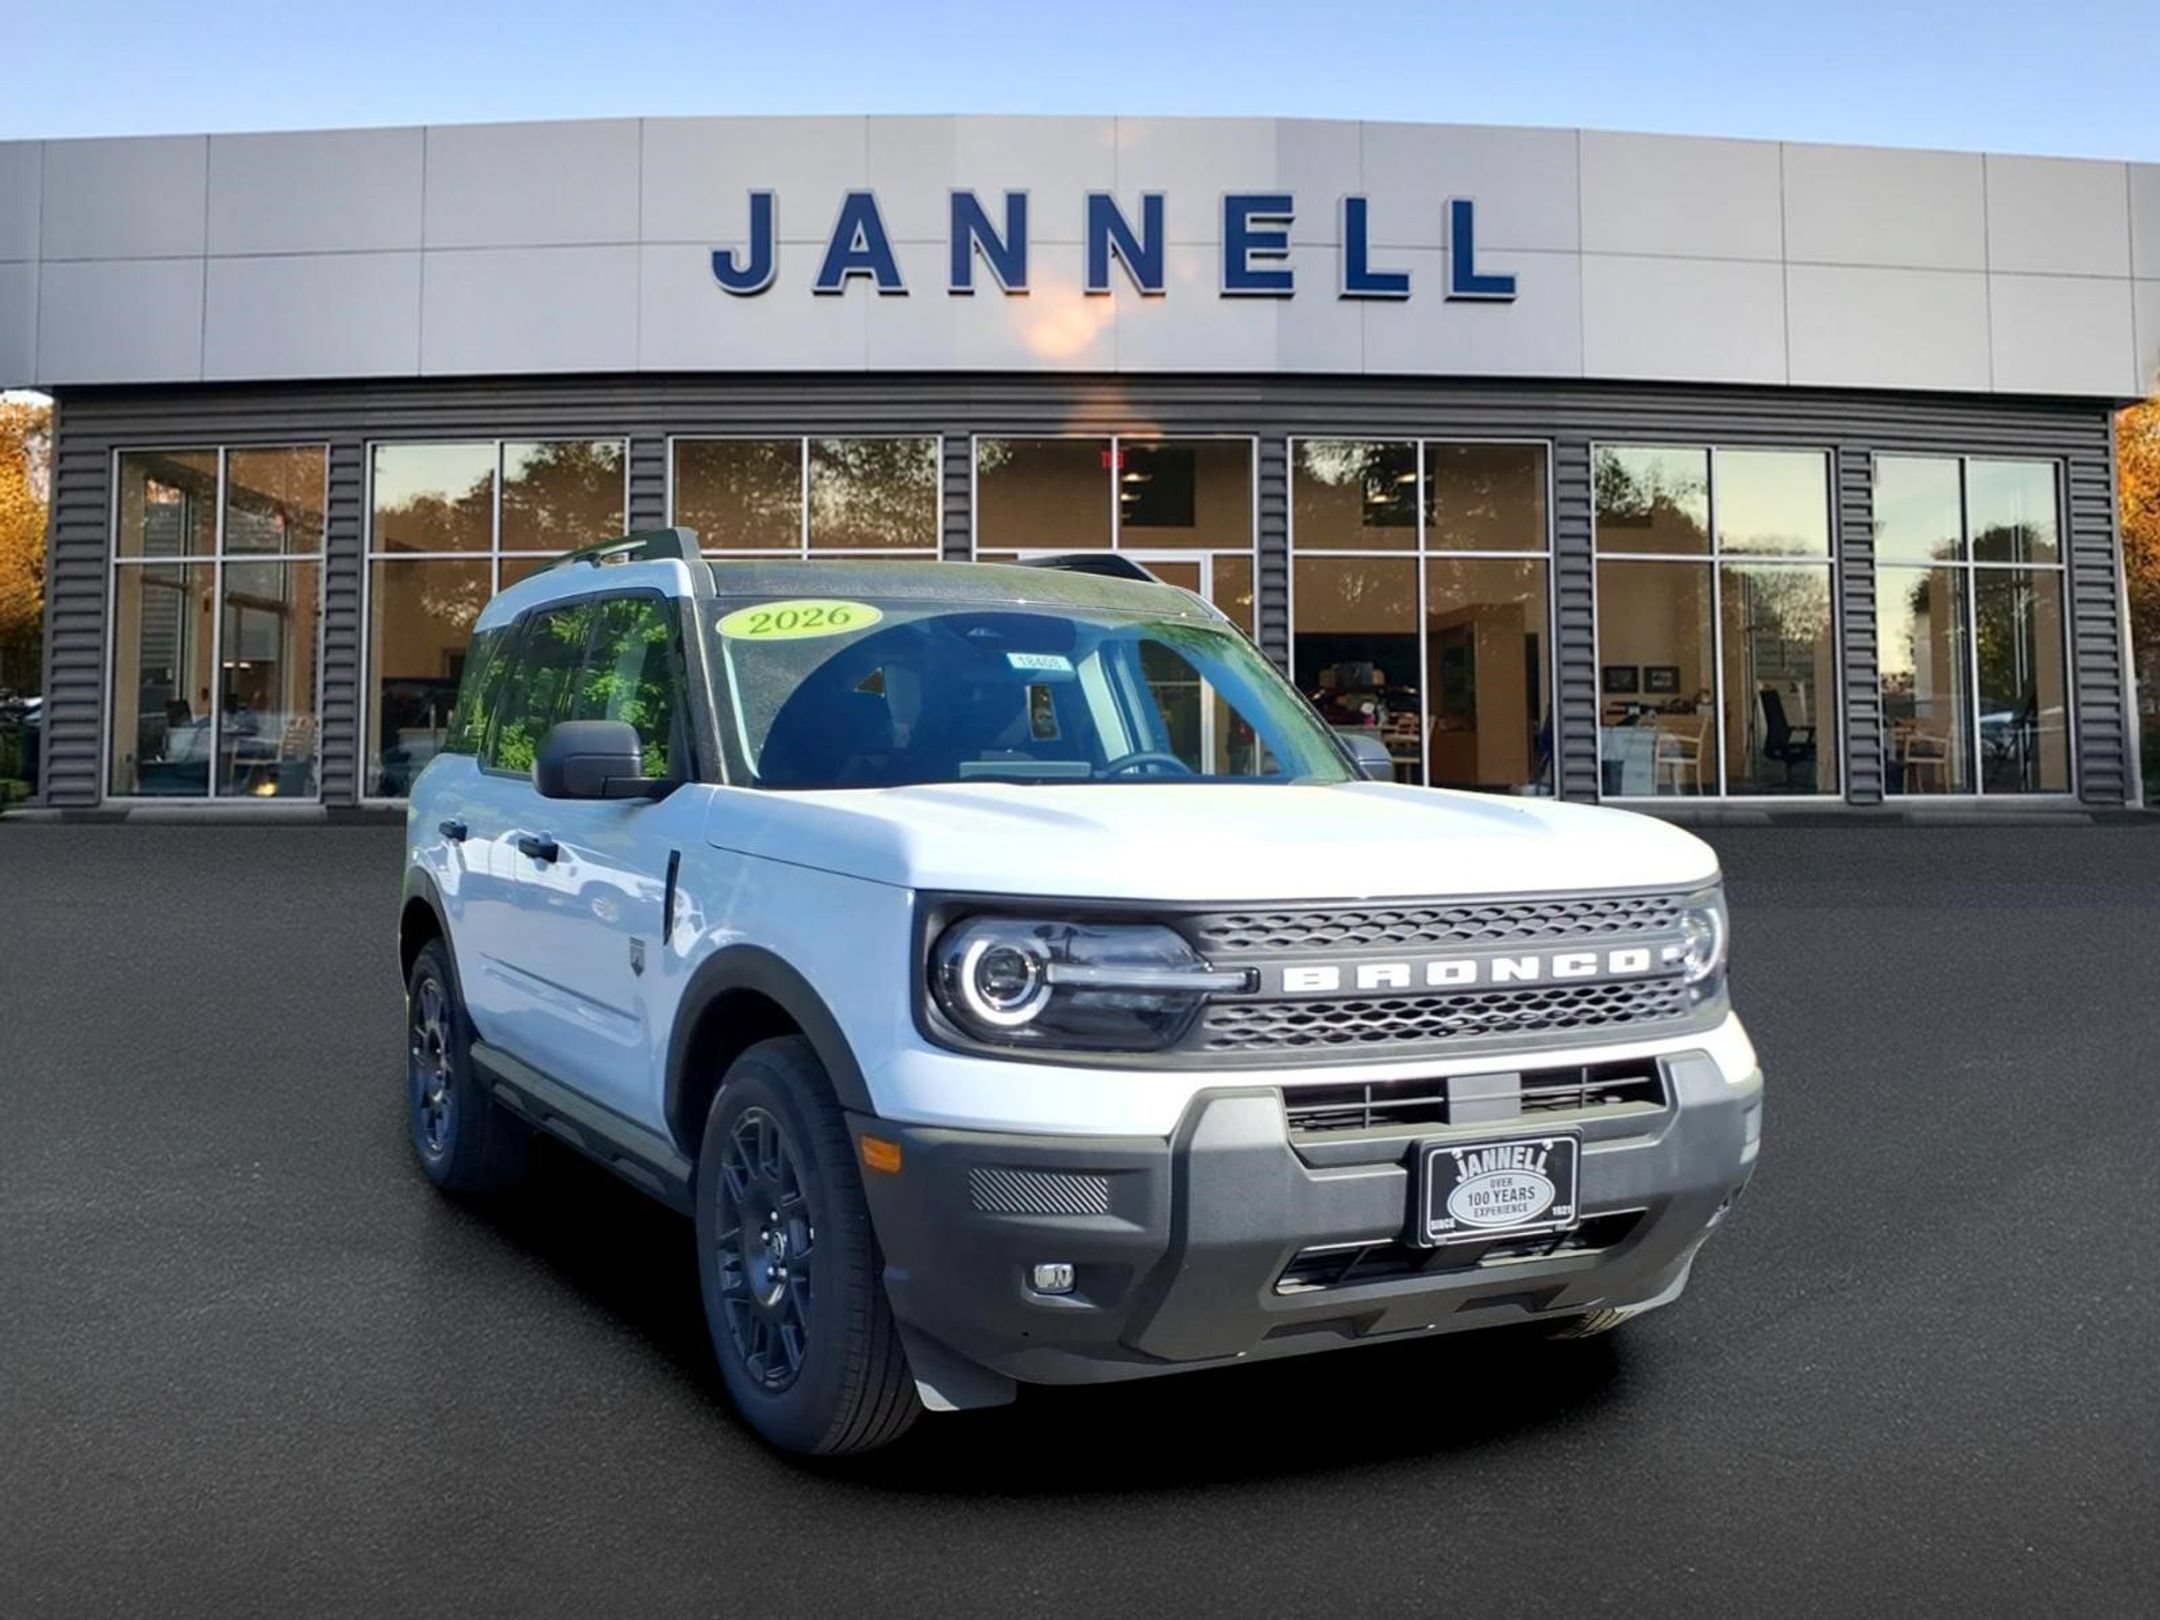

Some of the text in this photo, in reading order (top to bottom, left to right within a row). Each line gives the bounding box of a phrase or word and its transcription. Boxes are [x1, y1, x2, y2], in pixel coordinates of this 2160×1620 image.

[711, 188, 1517, 301] JANNELL
[749, 606, 851, 635] 2026
[1283, 948, 1650, 992] BRONCO
[1456, 1146, 1548, 1183] JANNELL
[1468, 1185, 1536, 1207] 100 YEARS
[1490, 1177, 1513, 1189] OVER
[1474, 1202, 1528, 1218] EXPERIENCE
